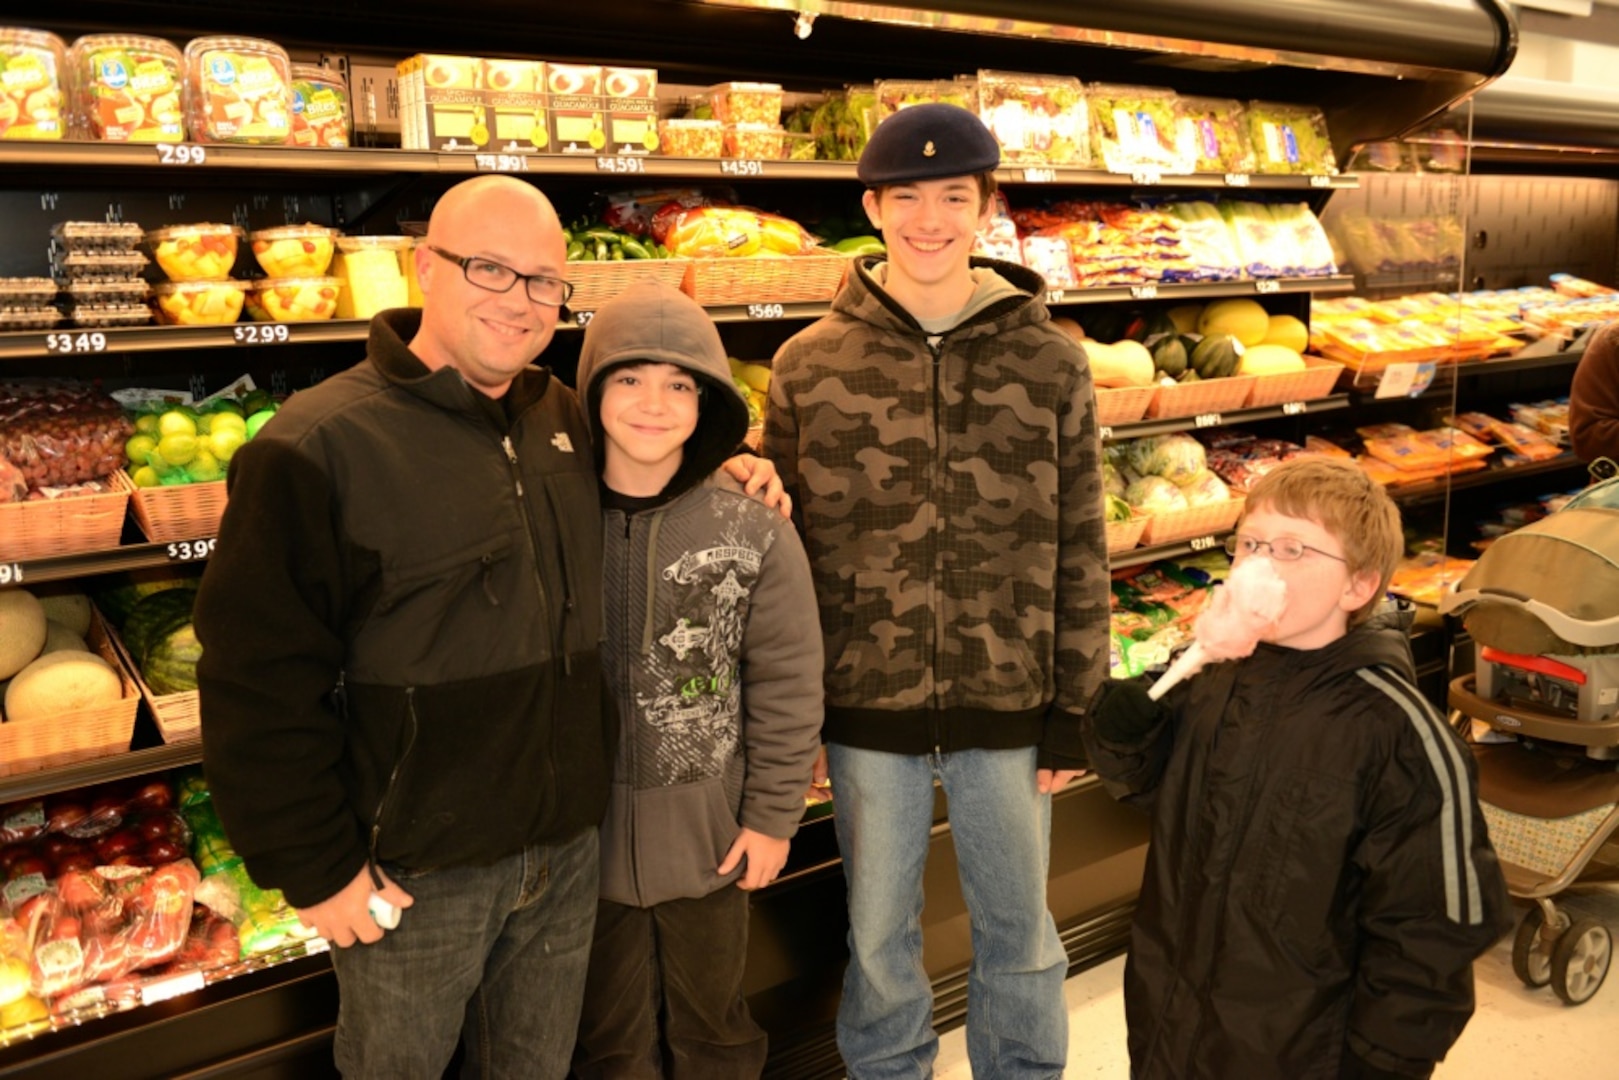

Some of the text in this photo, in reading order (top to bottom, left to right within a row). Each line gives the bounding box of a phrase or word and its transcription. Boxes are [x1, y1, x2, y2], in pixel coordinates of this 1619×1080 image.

[305, 102, 337, 114] Bites
[234, 325, 288, 342] $2.99
[47, 333, 106, 352] $3.49
